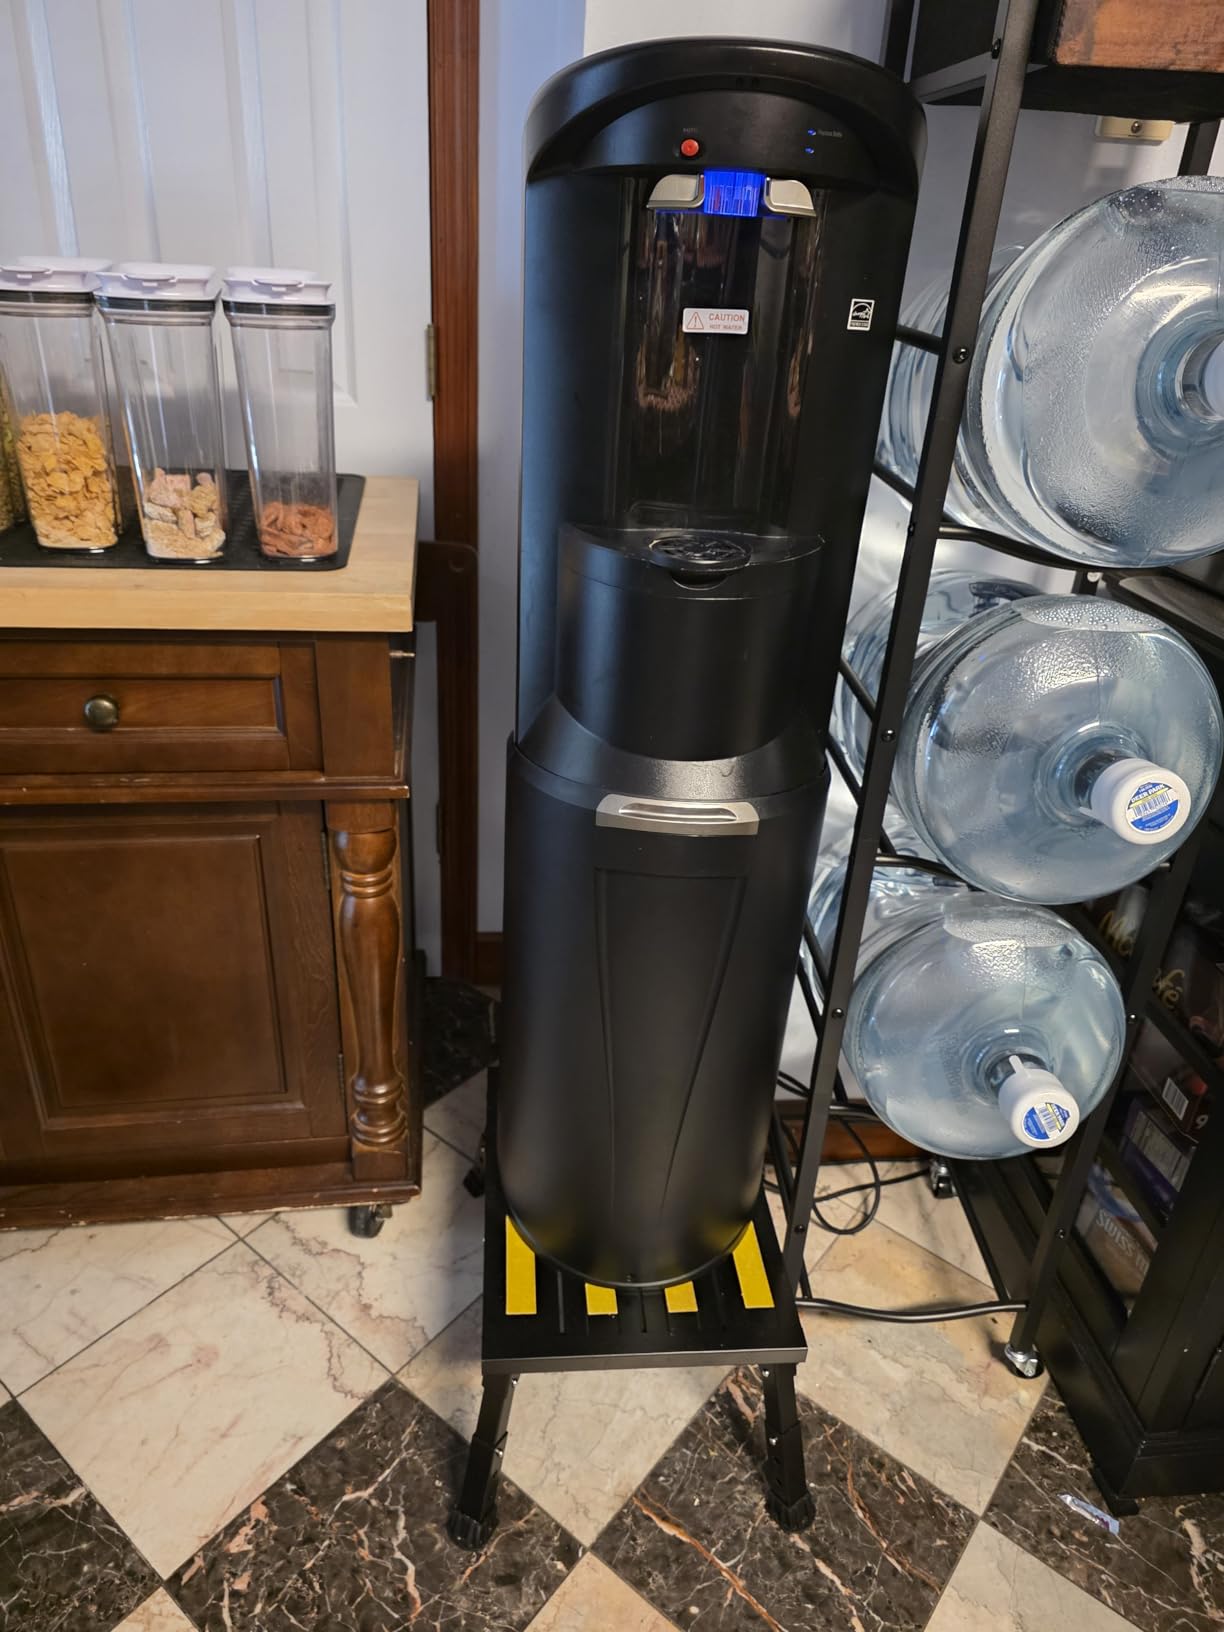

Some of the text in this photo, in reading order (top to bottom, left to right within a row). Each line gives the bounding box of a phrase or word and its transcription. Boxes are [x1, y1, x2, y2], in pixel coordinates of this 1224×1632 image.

[708, 313, 745, 322] CAUTION
[1131, 791, 1148, 803] DEER
[1148, 784, 1165, 795] PARK
